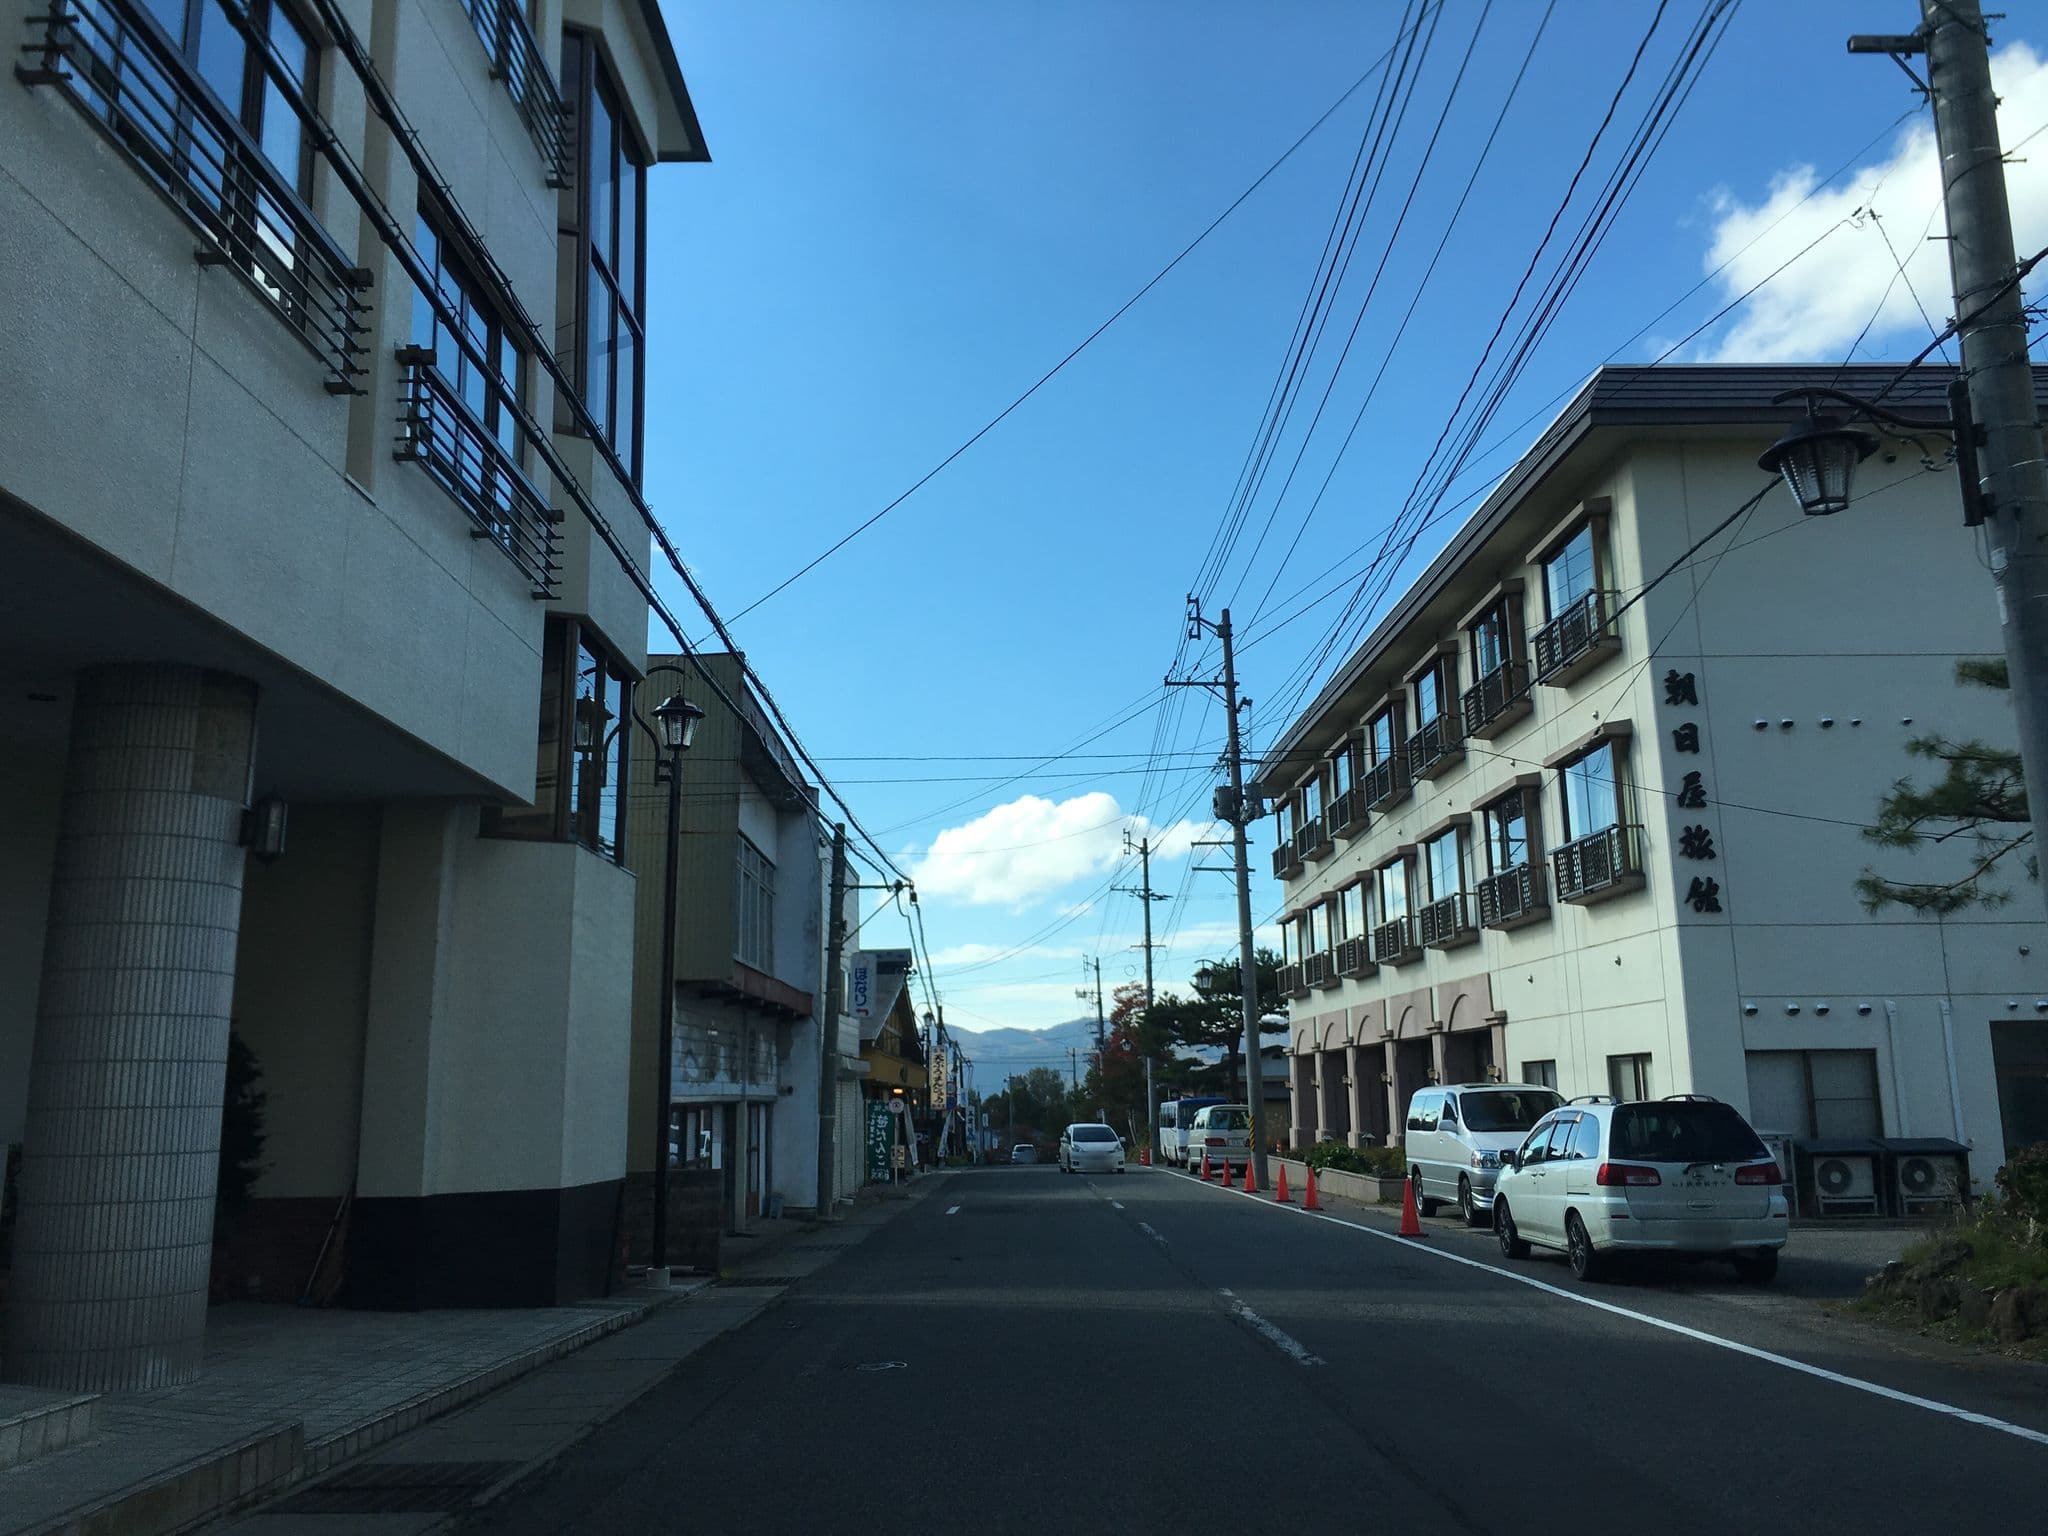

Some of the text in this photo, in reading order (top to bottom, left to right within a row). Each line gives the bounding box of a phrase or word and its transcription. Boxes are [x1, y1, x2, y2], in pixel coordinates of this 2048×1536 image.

[1664, 669, 1723, 913] 朝日屋旅館
